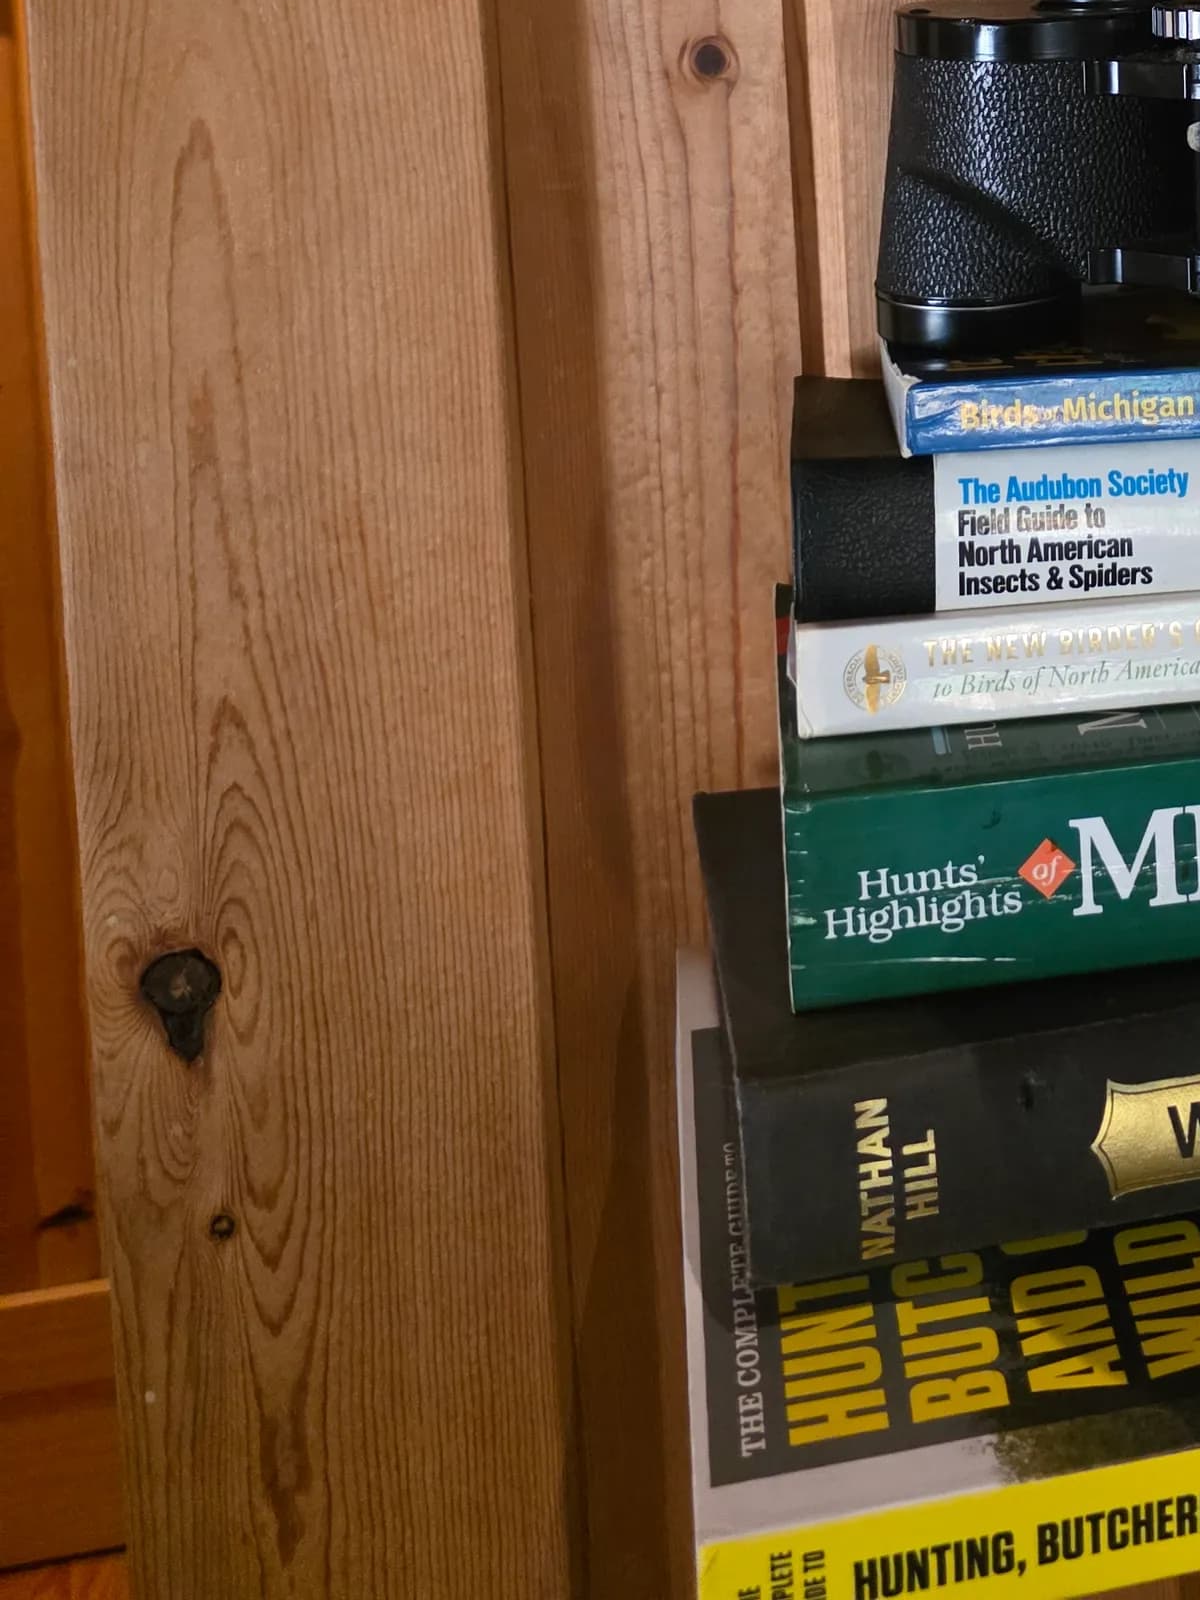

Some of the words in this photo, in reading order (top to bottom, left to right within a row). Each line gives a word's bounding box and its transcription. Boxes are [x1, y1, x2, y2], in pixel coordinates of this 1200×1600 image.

[960, 399, 1039, 430] Birds
[1063, 390, 1195, 425] Michigan
[958, 478, 1001, 505] The
[1006, 474, 1101, 502] Audubon
[1108, 469, 1189, 498] Society
[958, 506, 1010, 537] Field
[1016, 504, 1078, 533] Guide
[1084, 503, 1106, 528] to
[958, 538, 1022, 568] North
[1027, 534, 1133, 563] American
[958, 568, 1040, 596] Insects
[1046, 566, 1063, 590] &
[1069, 563, 1153, 592] Spiders
[923, 638, 974, 668] THE
[986, 631, 1047, 662] NEW
[1059, 622, 1184, 656] BIRDER'S
[933, 681, 952, 699] to
[960, 669, 1018, 697] Birds
[1022, 666, 1047, 696] of
[1048, 660, 1109, 689] North
[1113, 657, 1200, 682] America
[857, 855, 985, 901] Hunts'
[1031, 855, 1061, 881] of
[824, 887, 1023, 943] Highlights
[854, 1097, 896, 1261] NATHAN
[902, 1129, 940, 1221] HILL
[729, 1240, 761, 1388] COMPLETE
[1009, 1265, 1129, 1393] AND
[740, 1392, 767, 1458] THE
[802, 1550, 825, 1573] TO
[852, 1531, 1027, 1600] HUNTING,
